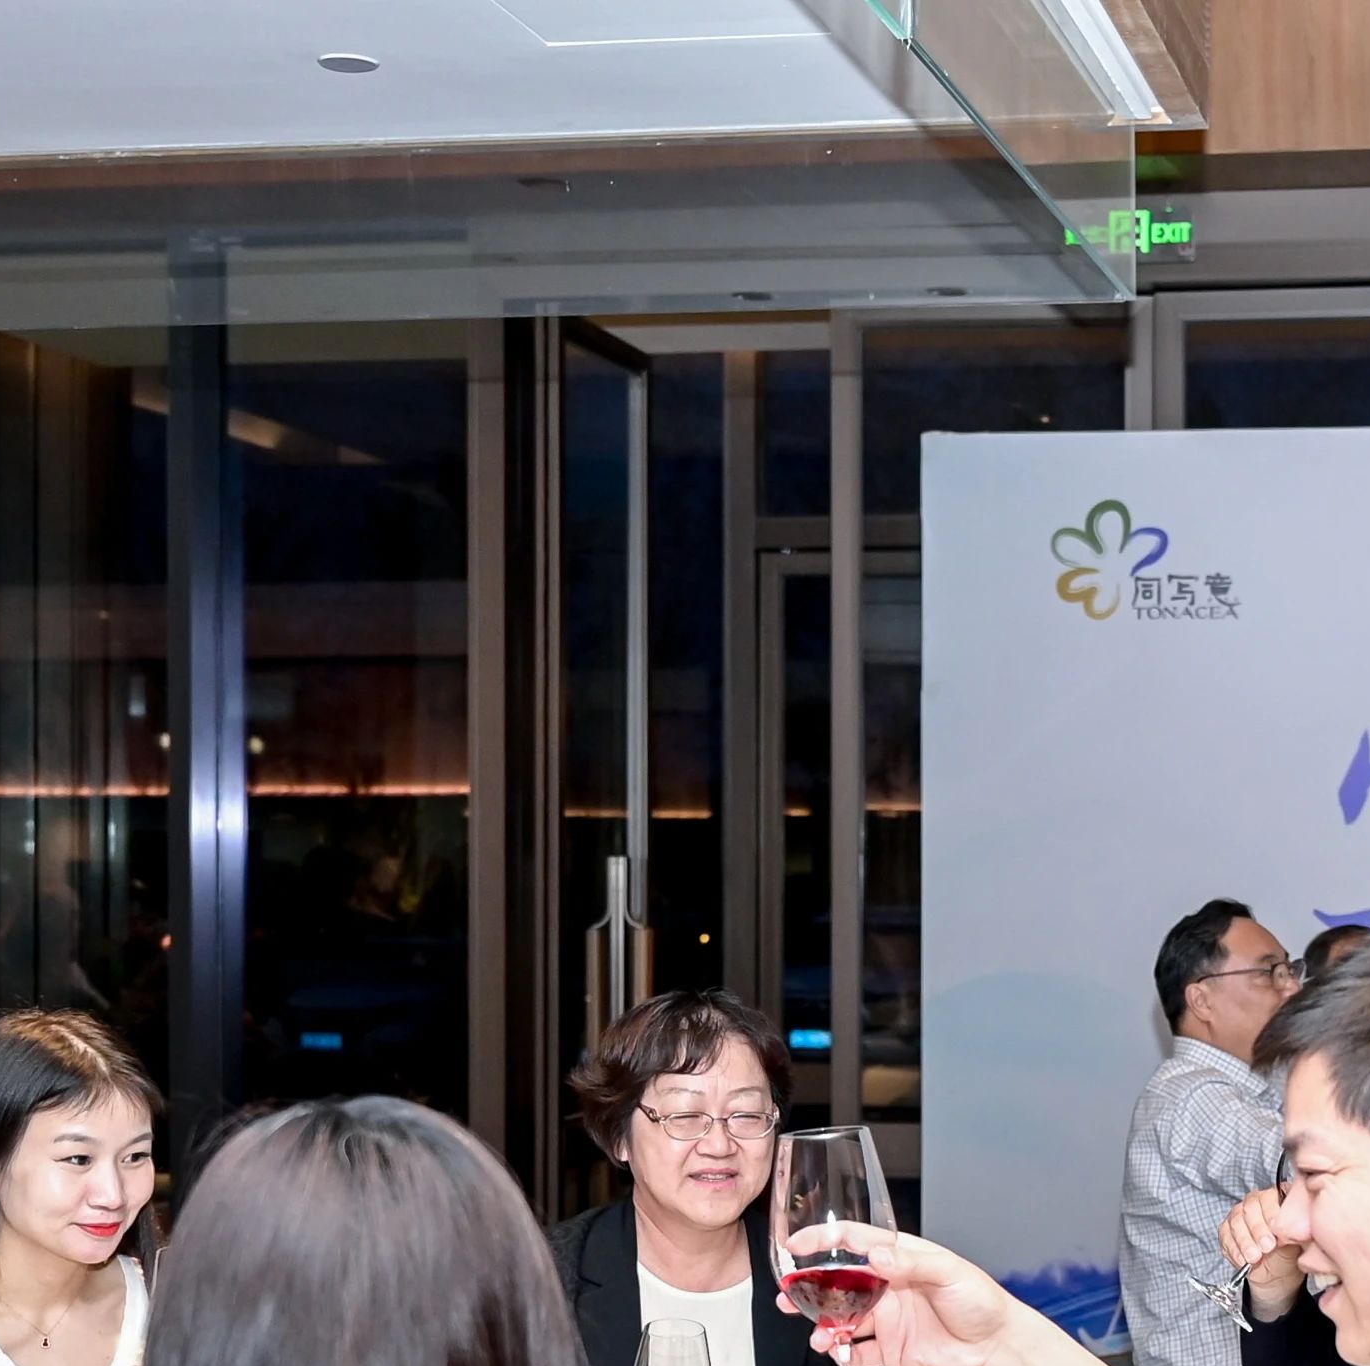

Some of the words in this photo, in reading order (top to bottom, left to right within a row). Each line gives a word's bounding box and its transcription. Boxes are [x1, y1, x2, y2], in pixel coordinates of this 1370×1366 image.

[1151, 222, 1192, 244] EXIT
[1132, 572, 1242, 608] 同写意
[1133, 605, 1239, 621] TONACEA
